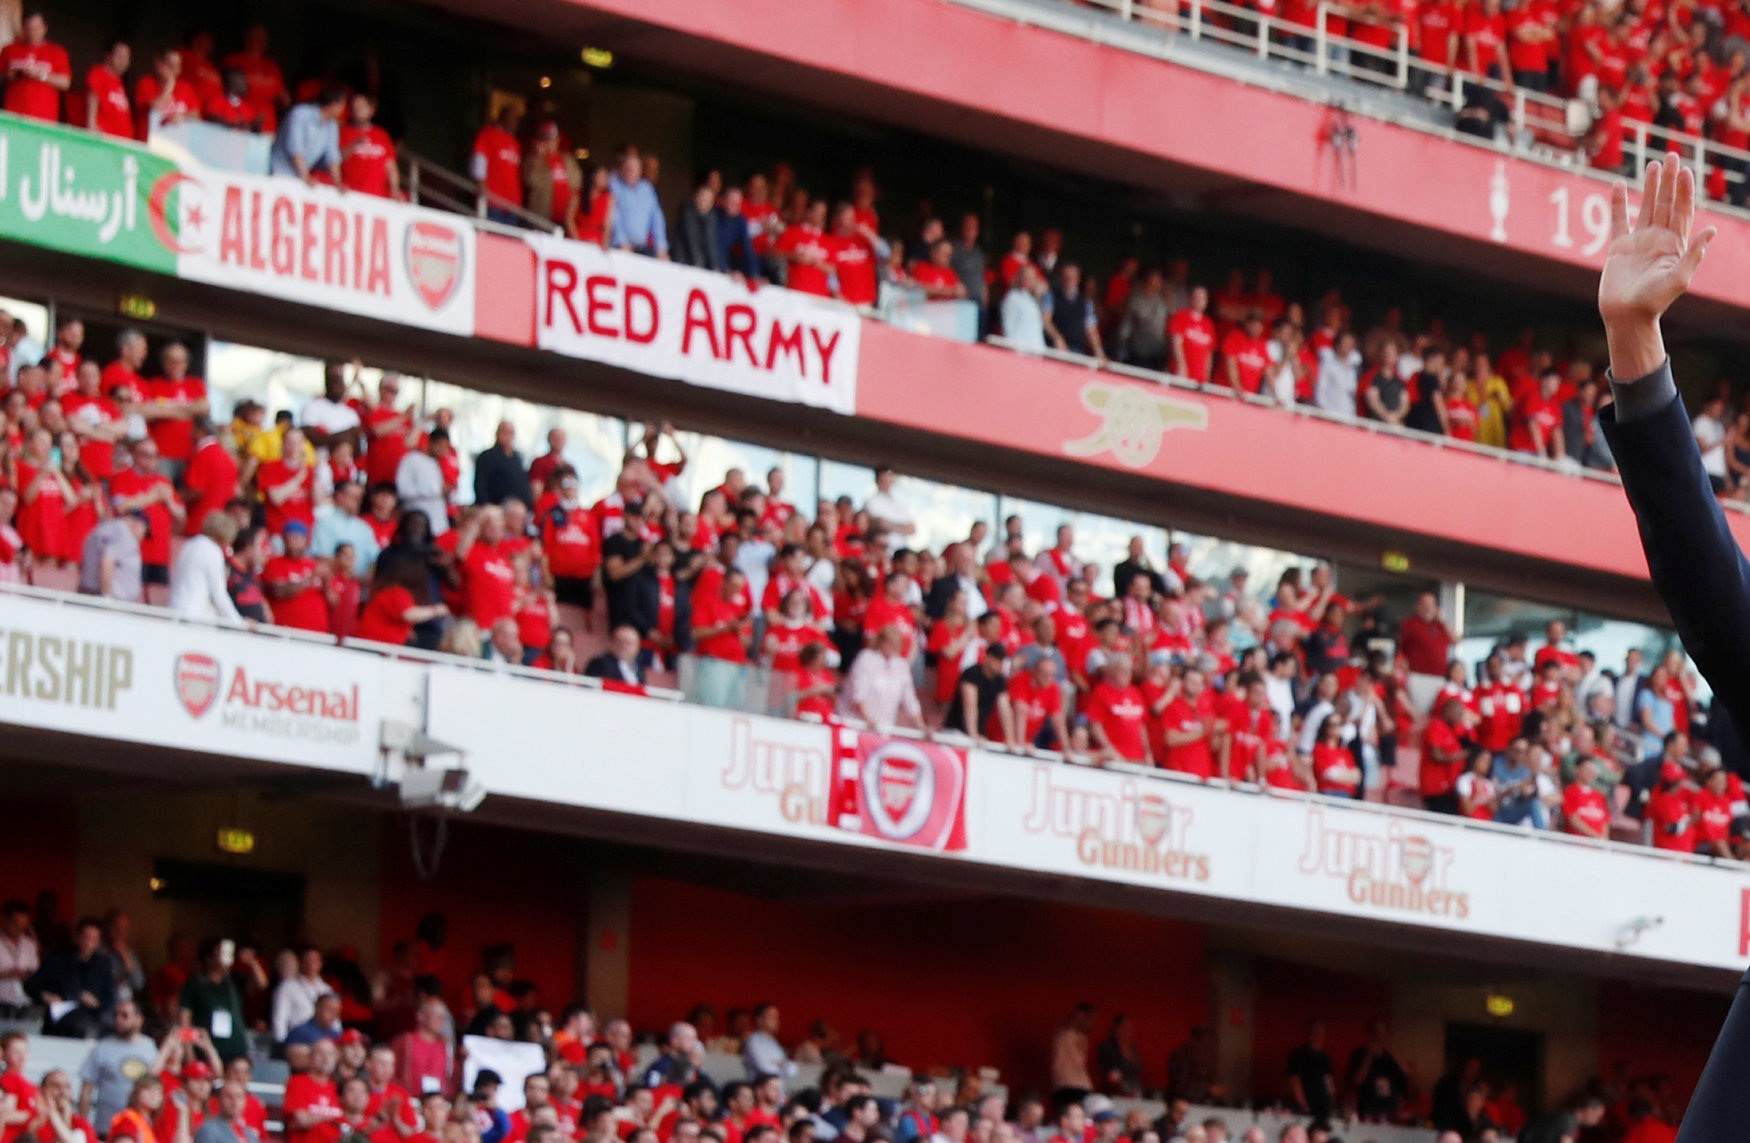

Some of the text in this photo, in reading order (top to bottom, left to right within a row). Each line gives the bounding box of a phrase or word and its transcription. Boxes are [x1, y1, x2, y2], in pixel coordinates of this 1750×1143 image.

[20, 139, 138, 243] أرسنال
[220, 185, 391, 297] ALGERIA
[545, 259, 840, 384] RED ARMY
[0, 630, 133, 709] RSHIP
[227, 665, 359, 721] Arsenal
[1077, 826, 1211, 882] Gunners
[1347, 867, 1470, 920] Gunners
